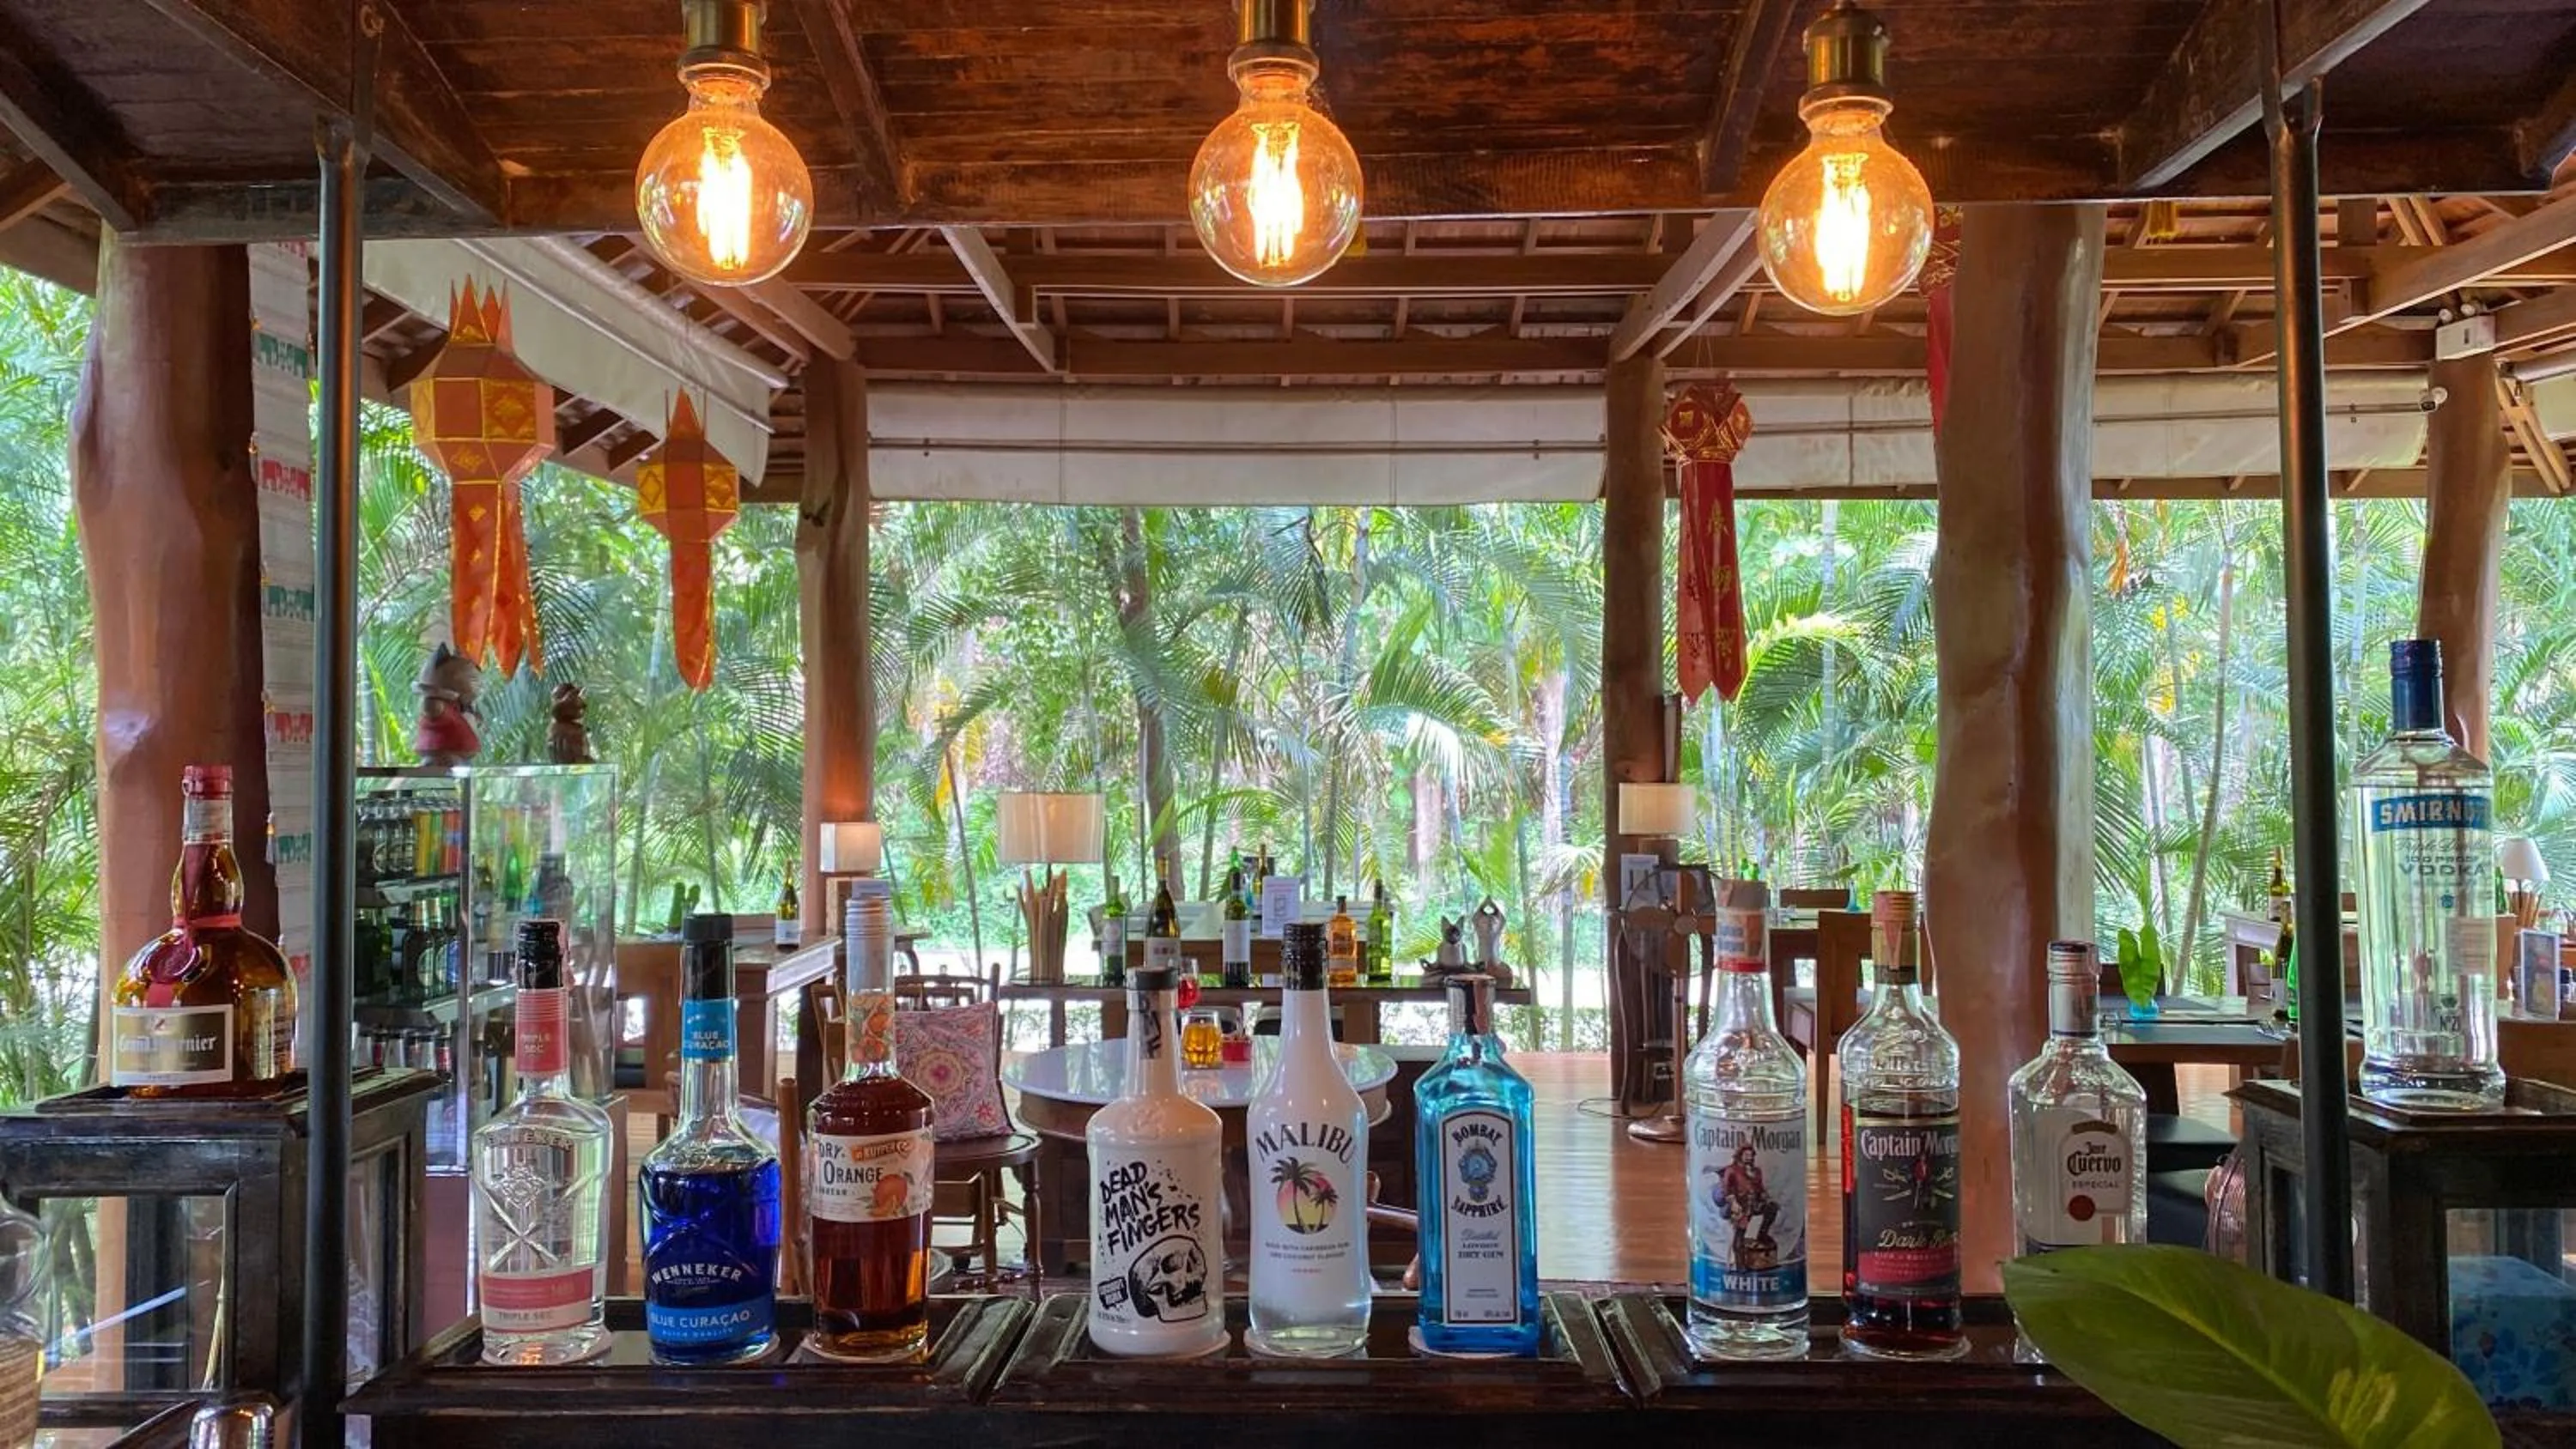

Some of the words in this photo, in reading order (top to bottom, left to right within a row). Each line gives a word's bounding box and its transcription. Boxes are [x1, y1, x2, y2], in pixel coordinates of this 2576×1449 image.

[2398, 863, 2486, 876] VODKA
[1255, 1122, 1357, 1165] MALIBU
[1451, 1123, 1504, 1148] BOMBAY
[1694, 1120, 1746, 1151] Captain
[1860, 1128, 1922, 1161] Captain
[1923, 1130, 1959, 1158] Morg
[823, 1160, 884, 1185] ORANGE
[2066, 1149, 2122, 1176] Cuervo
[1100, 1161, 1147, 1204] DEAD
[2071, 1180, 2119, 1190] ESPECIAL
[1104, 1181, 1163, 1230] MAN'S
[1450, 1194, 1510, 1218] SAPPHIRE
[1106, 1203, 1201, 1256] FINGERS
[1877, 1228, 1928, 1249] Dark
[652, 1263, 743, 1285] WENNEKER
[1722, 1274, 1780, 1292] WHITE
[649, 1311, 676, 1327] BLUE
[679, 1309, 750, 1327] CURAÇAO
